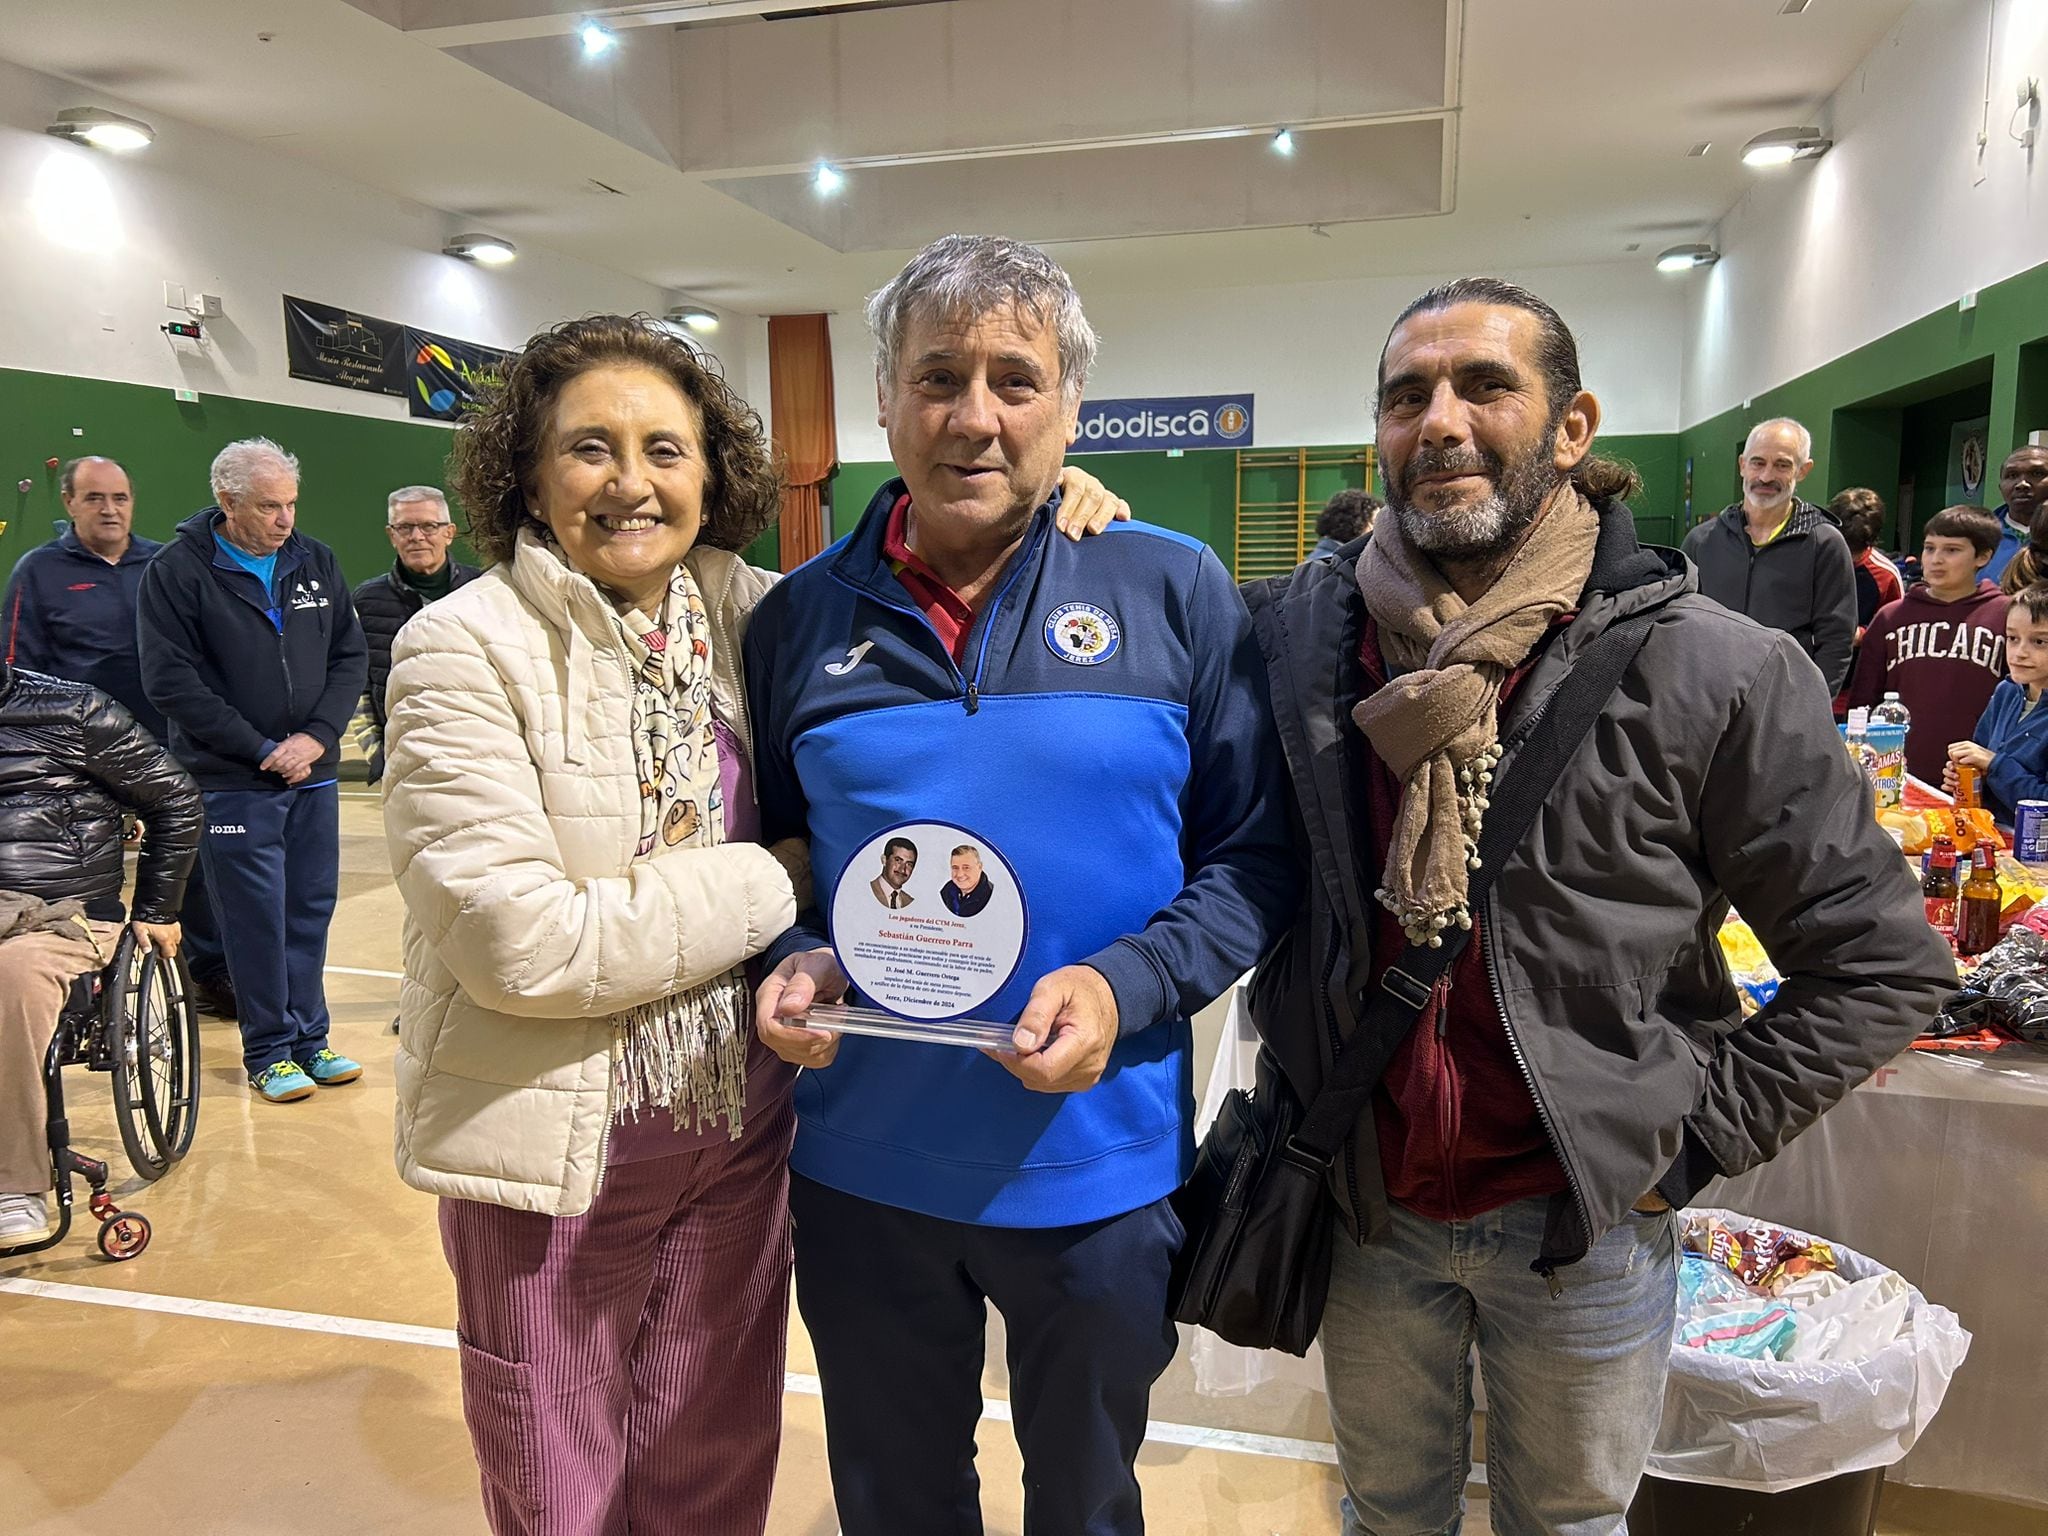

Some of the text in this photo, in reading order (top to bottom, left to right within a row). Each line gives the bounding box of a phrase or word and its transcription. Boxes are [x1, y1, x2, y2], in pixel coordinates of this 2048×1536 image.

[335, 369, 370, 386] Alcazaba
[1047, 604, 1118, 640] CLUB TENIS DE MESA
[1063, 653, 1095, 663] JEREZ
[878, 930, 973, 948] Sebastián Guerrero Parra
[915, 970, 940, 978] Guerrero
[941, 973, 960, 981] Ortega
[903, 996, 932, 1005] Diciembre
